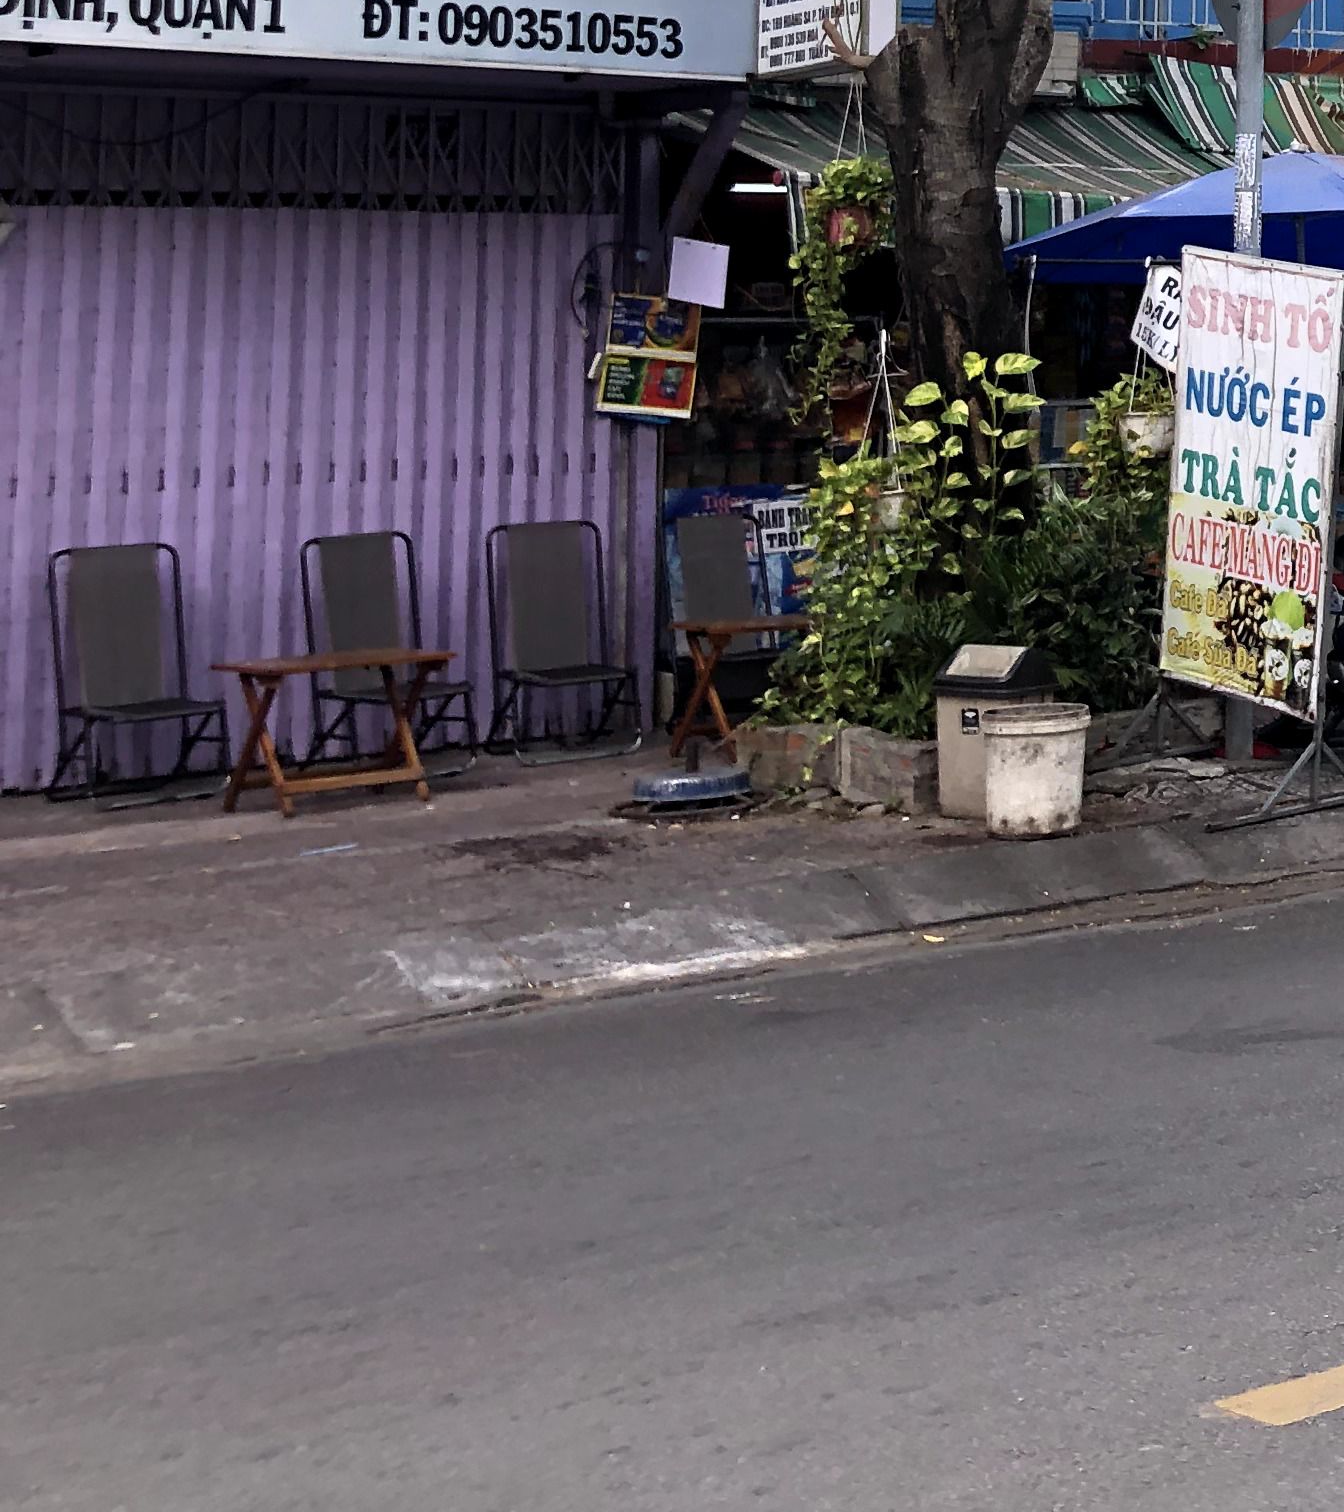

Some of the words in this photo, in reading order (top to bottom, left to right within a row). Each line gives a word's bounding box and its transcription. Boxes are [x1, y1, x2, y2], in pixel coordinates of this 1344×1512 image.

[438, 2, 684, 59] 0903510553
[1187, 285, 1275, 343] SINH
[1284, 287, 1335, 354] TỐ
[1186, 366, 1271, 427] NƯỚC
[1282, 376, 1326, 437] ÉP
[1181, 446, 1244, 506] TRÀ
[1255, 447, 1321, 523] TẮC
[1171, 512, 1226, 570] CAFE
[1228, 524, 1291, 588] MANG
[1296, 541, 1322, 596] ĐI
